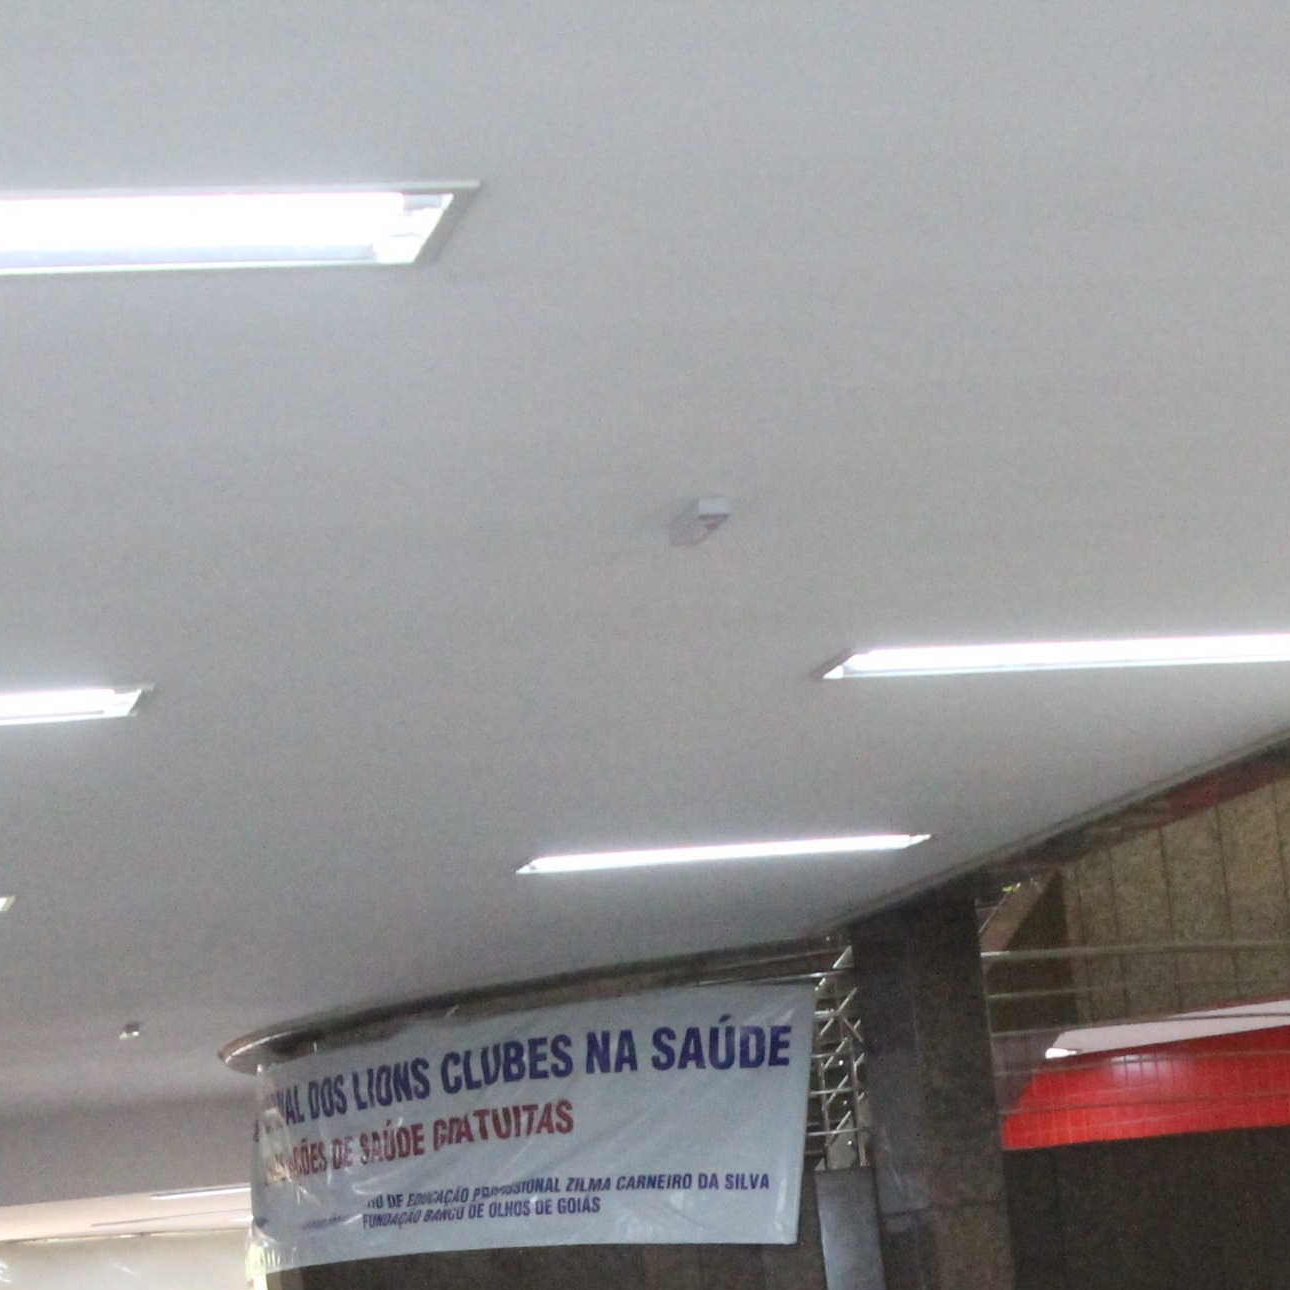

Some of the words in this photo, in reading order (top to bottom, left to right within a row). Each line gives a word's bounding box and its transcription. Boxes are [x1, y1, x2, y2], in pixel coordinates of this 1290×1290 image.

[308, 1074, 348, 1120] DOS
[352, 1057, 431, 1111] LIONS
[440, 1033, 574, 1094] CLUBES
[585, 1029, 638, 1074] NA
[651, 1013, 793, 1071] SAÚDE
[332, 1137, 354, 1170] DE
[359, 1119, 426, 1165] SAÚDE
[362, 1208, 421, 1230] FUNDAÇÃO
[468, 1202, 484, 1219] DE
[489, 1200, 530, 1218] OLHOS
[535, 1200, 553, 1215] DE
[557, 1195, 601, 1214] GOIÁS
[389, 1192, 407, 1209] DE
[407, 1186, 470, 1208] EDUCAÇÃO
[565, 1177, 611, 1192] ZILMA
[615, 1174, 692, 1191] CARNEIRO
[698, 1173, 719, 1190] DA
[724, 1173, 770, 1190] SILVA
